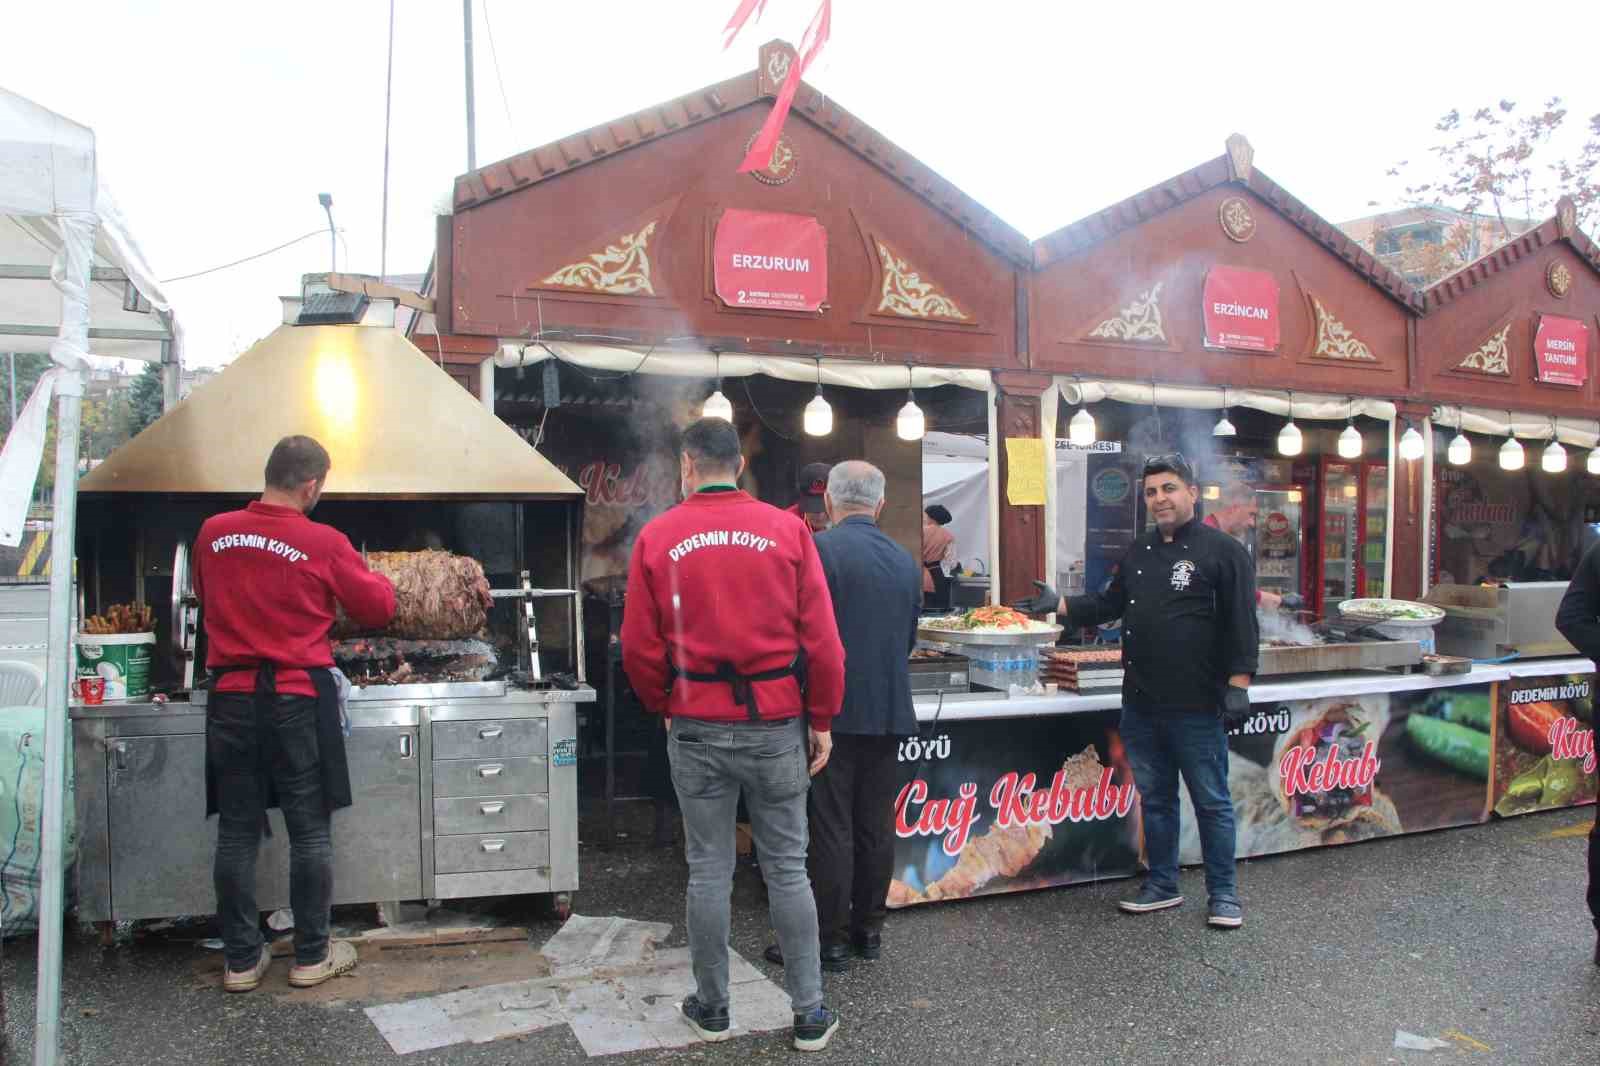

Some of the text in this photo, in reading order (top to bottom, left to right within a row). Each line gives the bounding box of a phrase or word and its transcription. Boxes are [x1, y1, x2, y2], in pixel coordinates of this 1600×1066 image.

[732, 254, 809, 273] ERZURUM
[1213, 300, 1269, 320] ERZİNCAN
[267, 538, 301, 562] KÖYÜ
[668, 530, 769, 562] DEDEMİN KÖYÜ
[1511, 681, 1590, 704] DEDEMİN KÖYÜ
[1243, 710, 1289, 735] KÖYÜ
[1279, 740, 1382, 796] Kebab
[894, 767, 1135, 856] Cağ Kebabı
